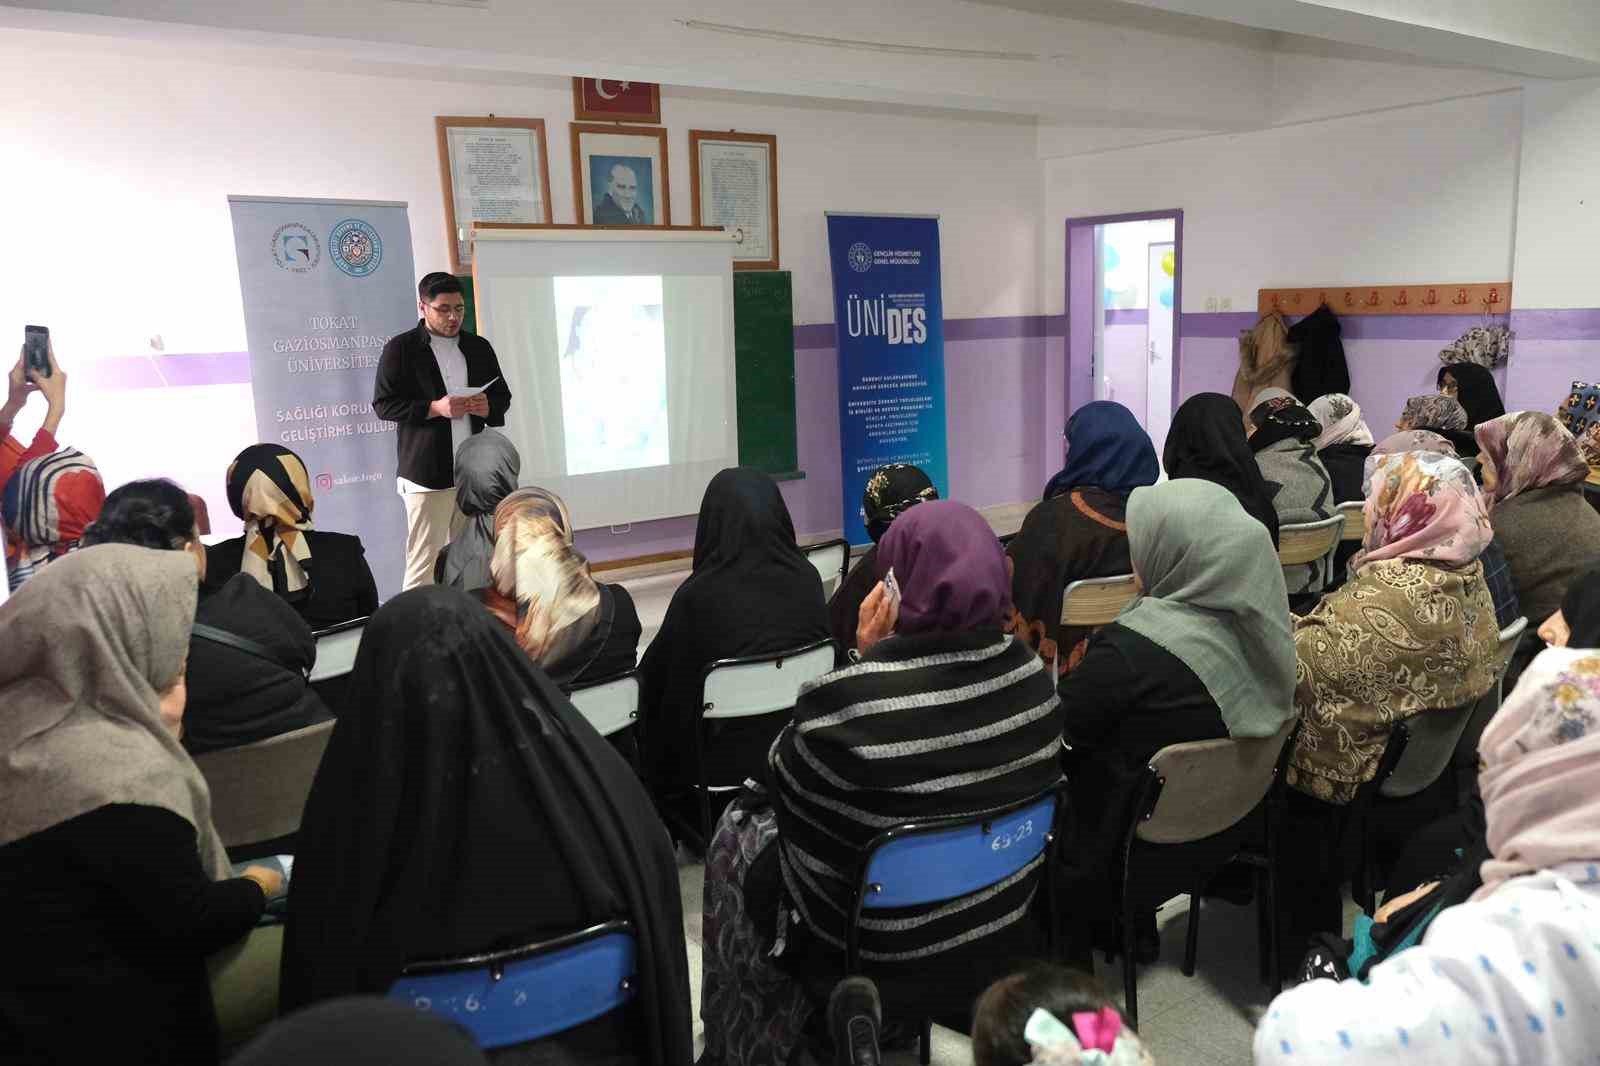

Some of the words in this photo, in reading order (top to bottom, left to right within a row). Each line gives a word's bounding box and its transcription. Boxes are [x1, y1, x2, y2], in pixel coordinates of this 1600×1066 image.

[311, 316, 360, 330] TOKAT
[287, 354, 380, 373] ÜNİVERSİTES
[276, 405, 328, 422] SAĞLIĞI
[332, 402, 375, 417] KORU
[281, 423, 353, 443] GELİŞTİRME
[357, 419, 397, 433] KULÜB
